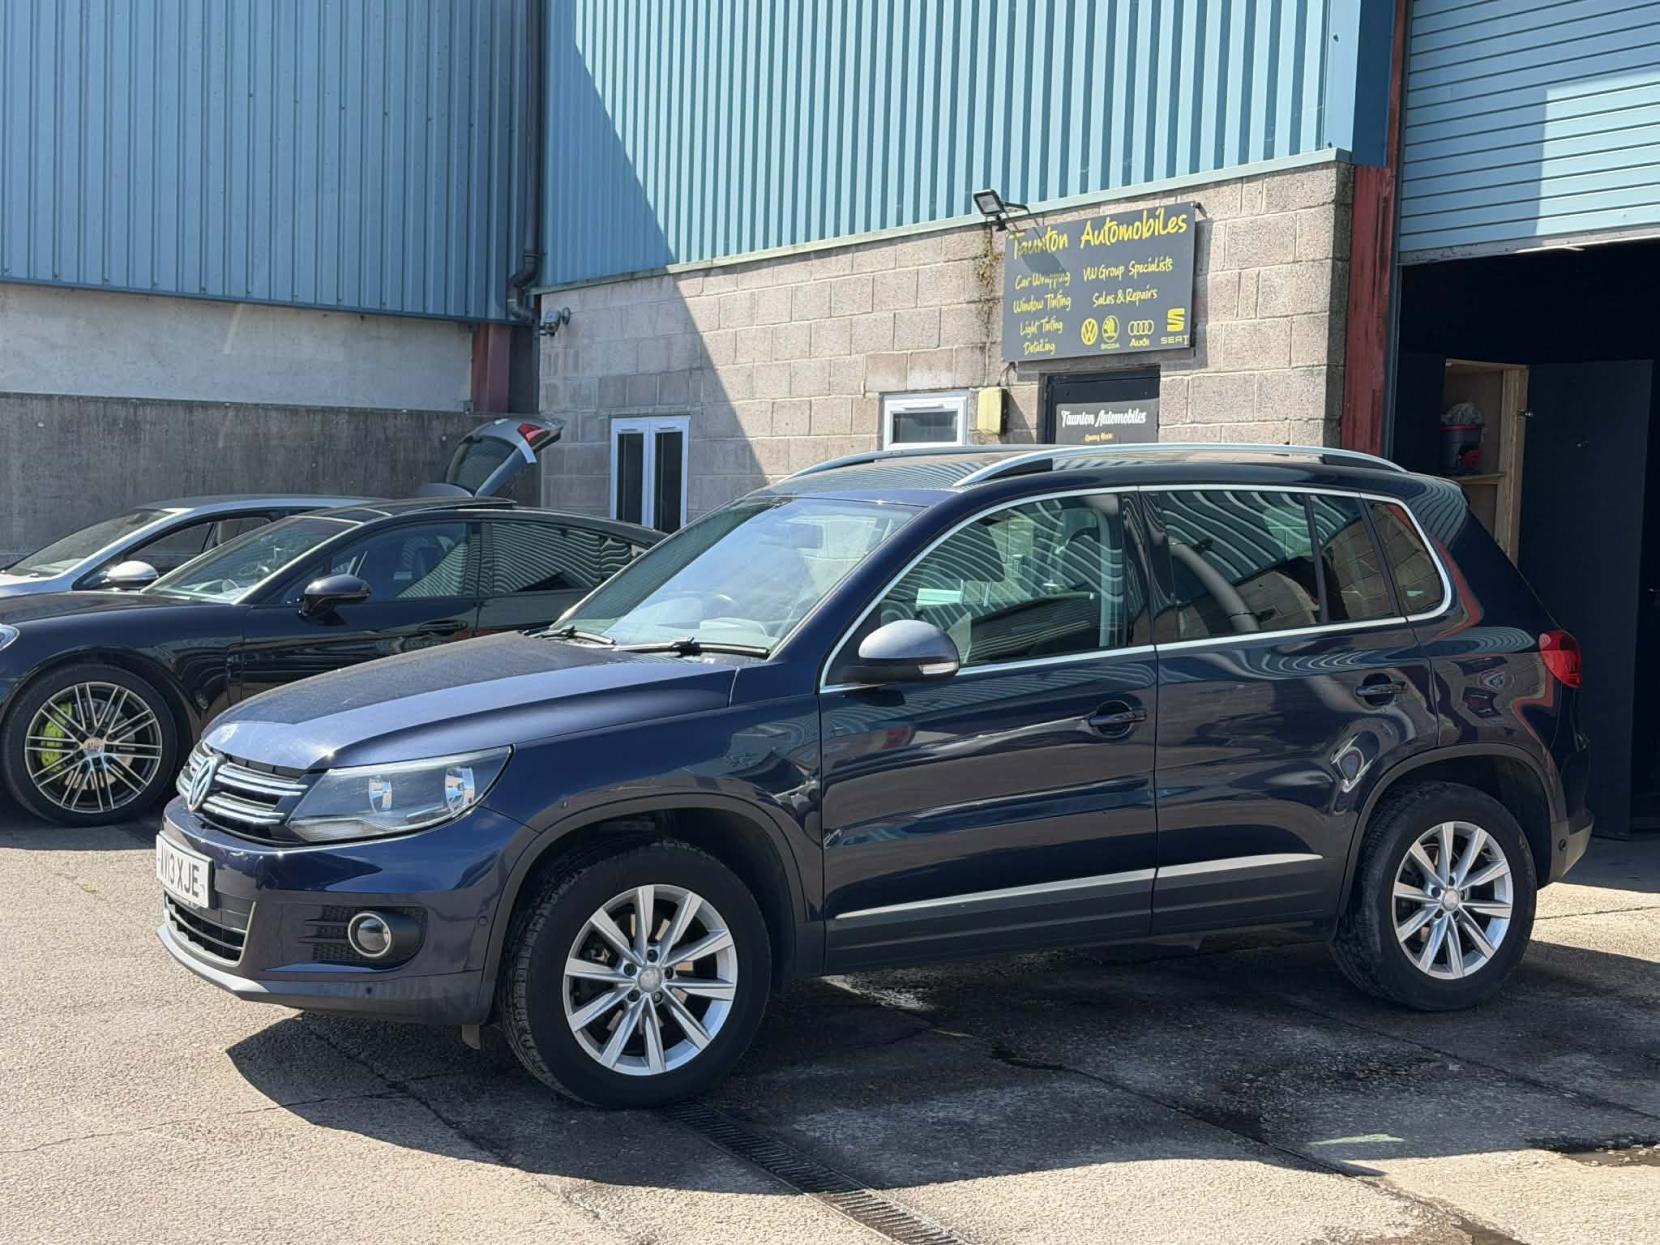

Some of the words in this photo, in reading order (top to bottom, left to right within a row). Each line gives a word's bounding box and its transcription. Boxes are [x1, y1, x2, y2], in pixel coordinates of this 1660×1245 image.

[1008, 226, 1068, 260] Taunton
[1079, 208, 1187, 249] Automobiles
[1098, 264, 1125, 281] Group
[1128, 256, 1173, 279] Specialists
[1015, 274, 1031, 290] Car
[1013, 295, 1044, 314] Window
[1044, 289, 1072, 312] Tinting
[1092, 290, 1115, 308] Sales
[1125, 284, 1158, 307] Repairs
[1020, 320, 1041, 338] Light
[1040, 315, 1064, 334] Tinting
[1023, 338, 1055, 356] Detailing
[1129, 338, 1150, 347] Audi
[1160, 335, 1190, 345] SEAT
[1061, 410, 1095, 428] Taunton
[1094, 408, 1147, 428] Automobiles
[177, 857, 200, 897] XJE
